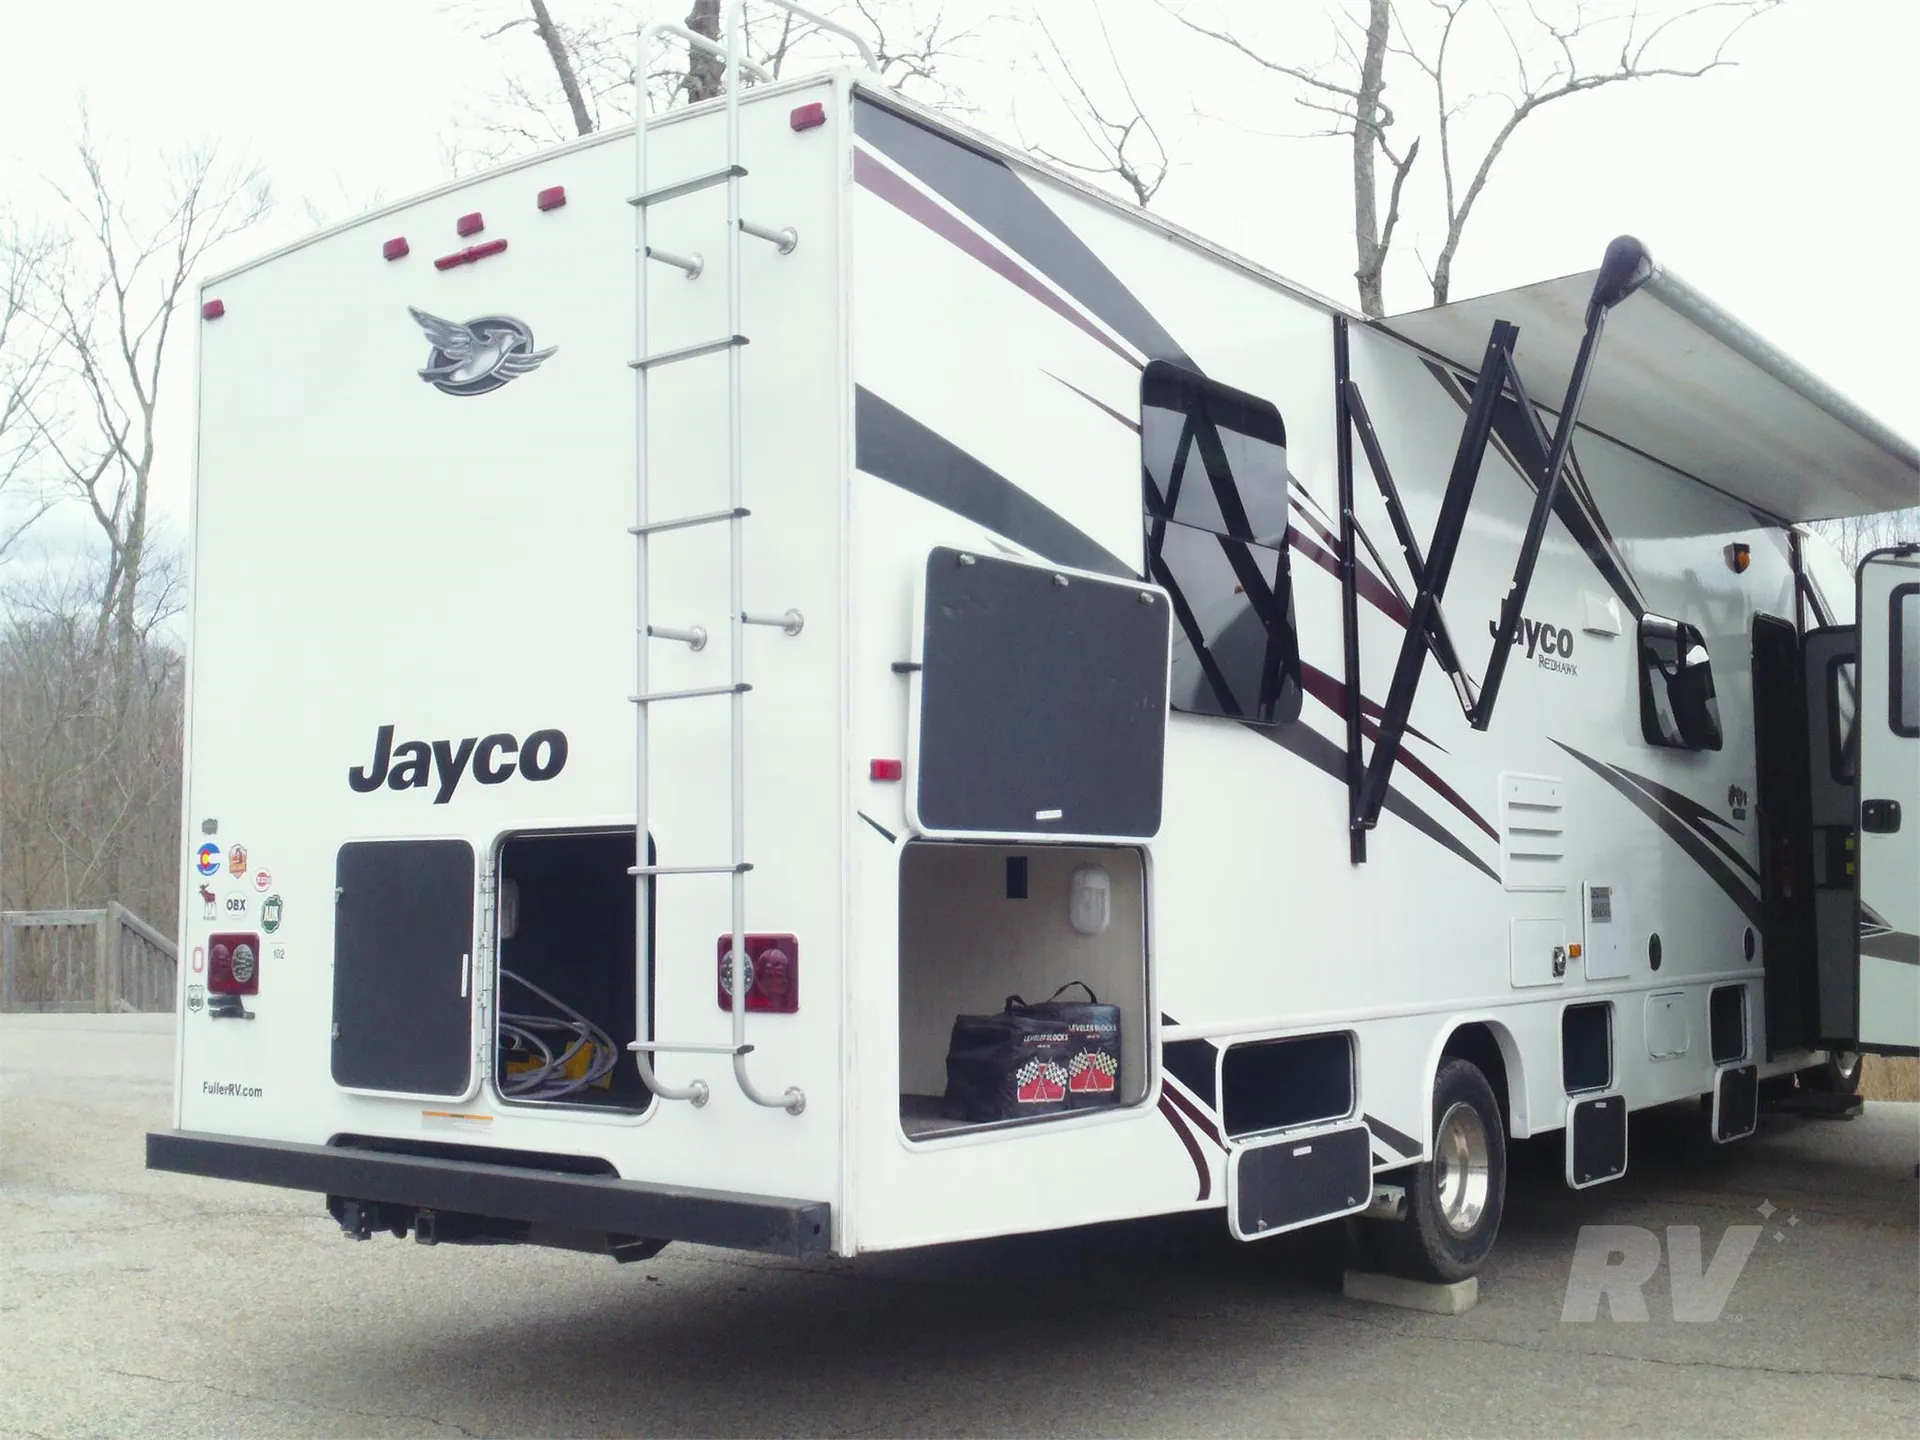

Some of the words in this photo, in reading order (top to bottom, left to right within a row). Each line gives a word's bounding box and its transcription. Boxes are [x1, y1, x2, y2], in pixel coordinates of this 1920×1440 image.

[1538, 654, 1578, 677] REDHAWK
[349, 725, 568, 805] Jayco
[226, 899, 246, 911] OBX
[203, 1081, 263, 1098] FullerRV.com
